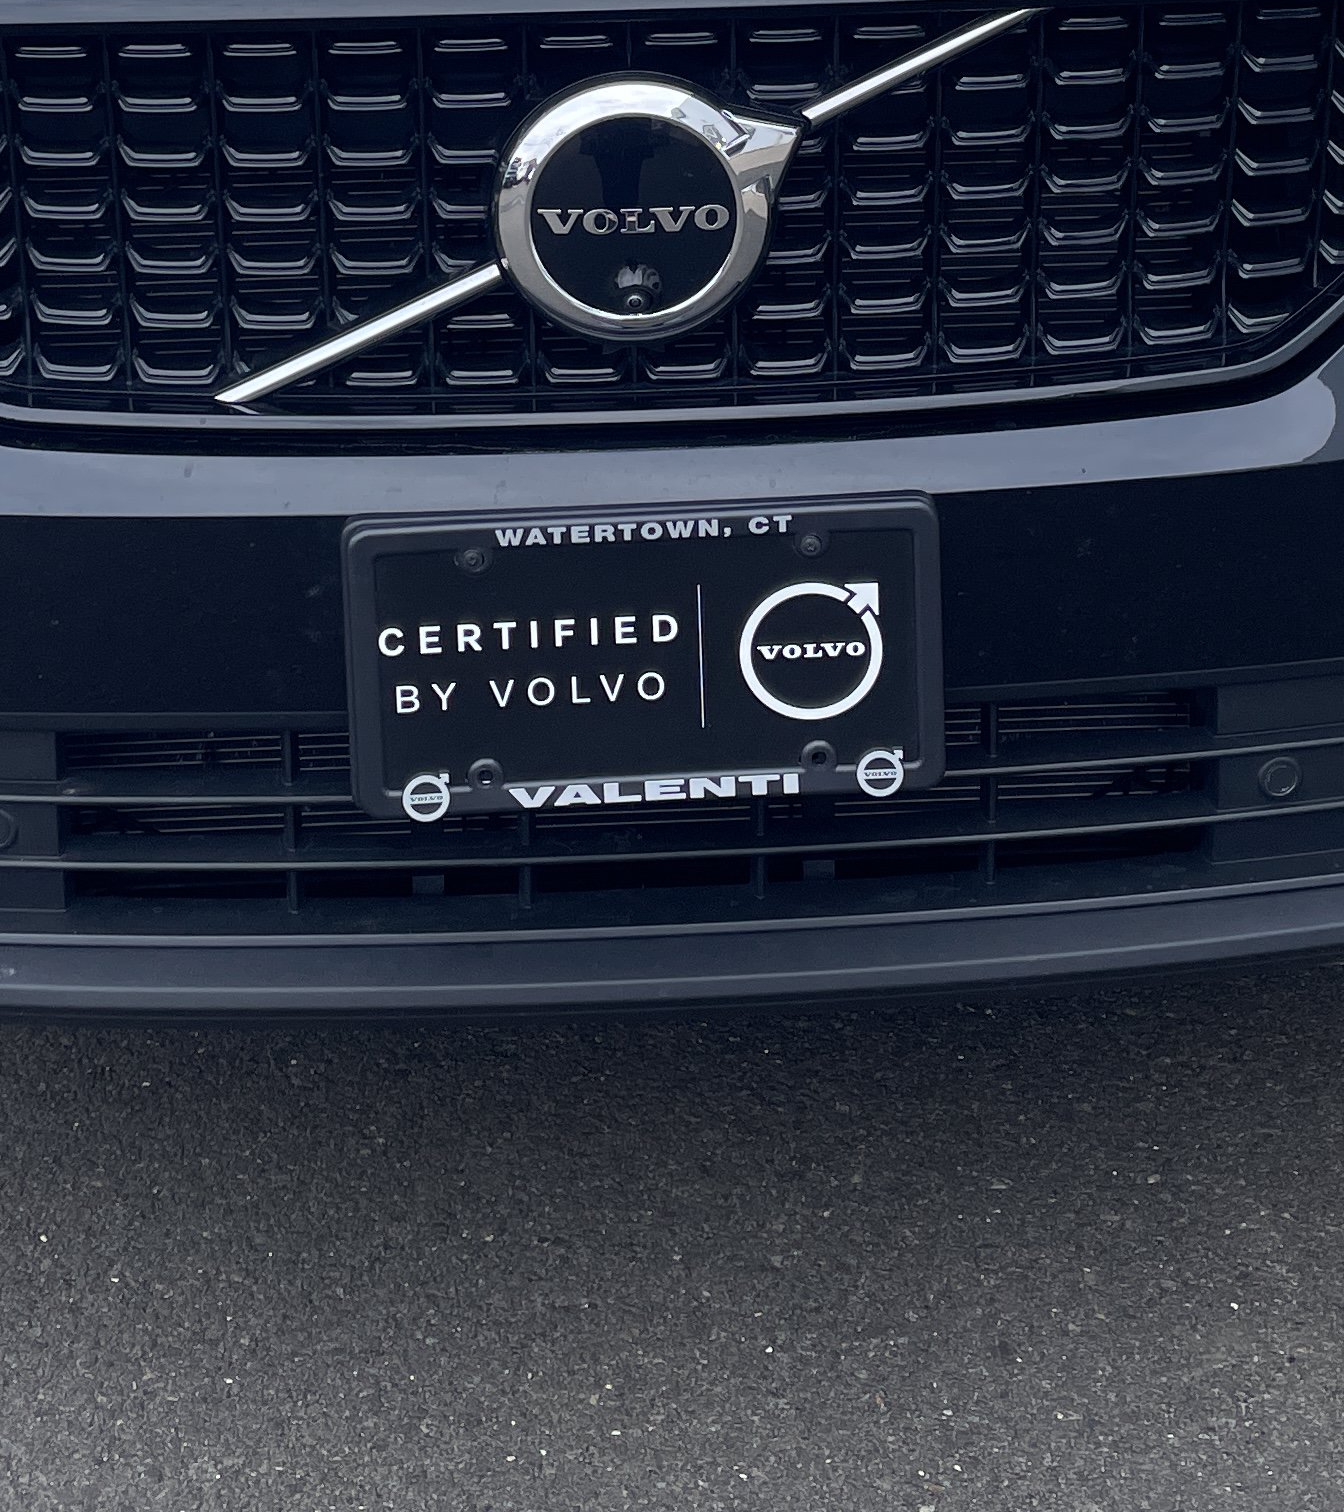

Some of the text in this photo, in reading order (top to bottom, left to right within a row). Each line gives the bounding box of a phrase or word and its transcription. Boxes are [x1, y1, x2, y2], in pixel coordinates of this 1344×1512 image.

[536, 204, 730, 236] VOLVO
[494, 514, 794, 548] WATERTOWN, CT
[376, 612, 679, 658] CERTIFIED
[756, 639, 867, 661] VOLVO
[395, 670, 667, 714] BY VOLVO
[409, 795, 444, 803] VOLVO
[508, 772, 800, 809] VALENTI
